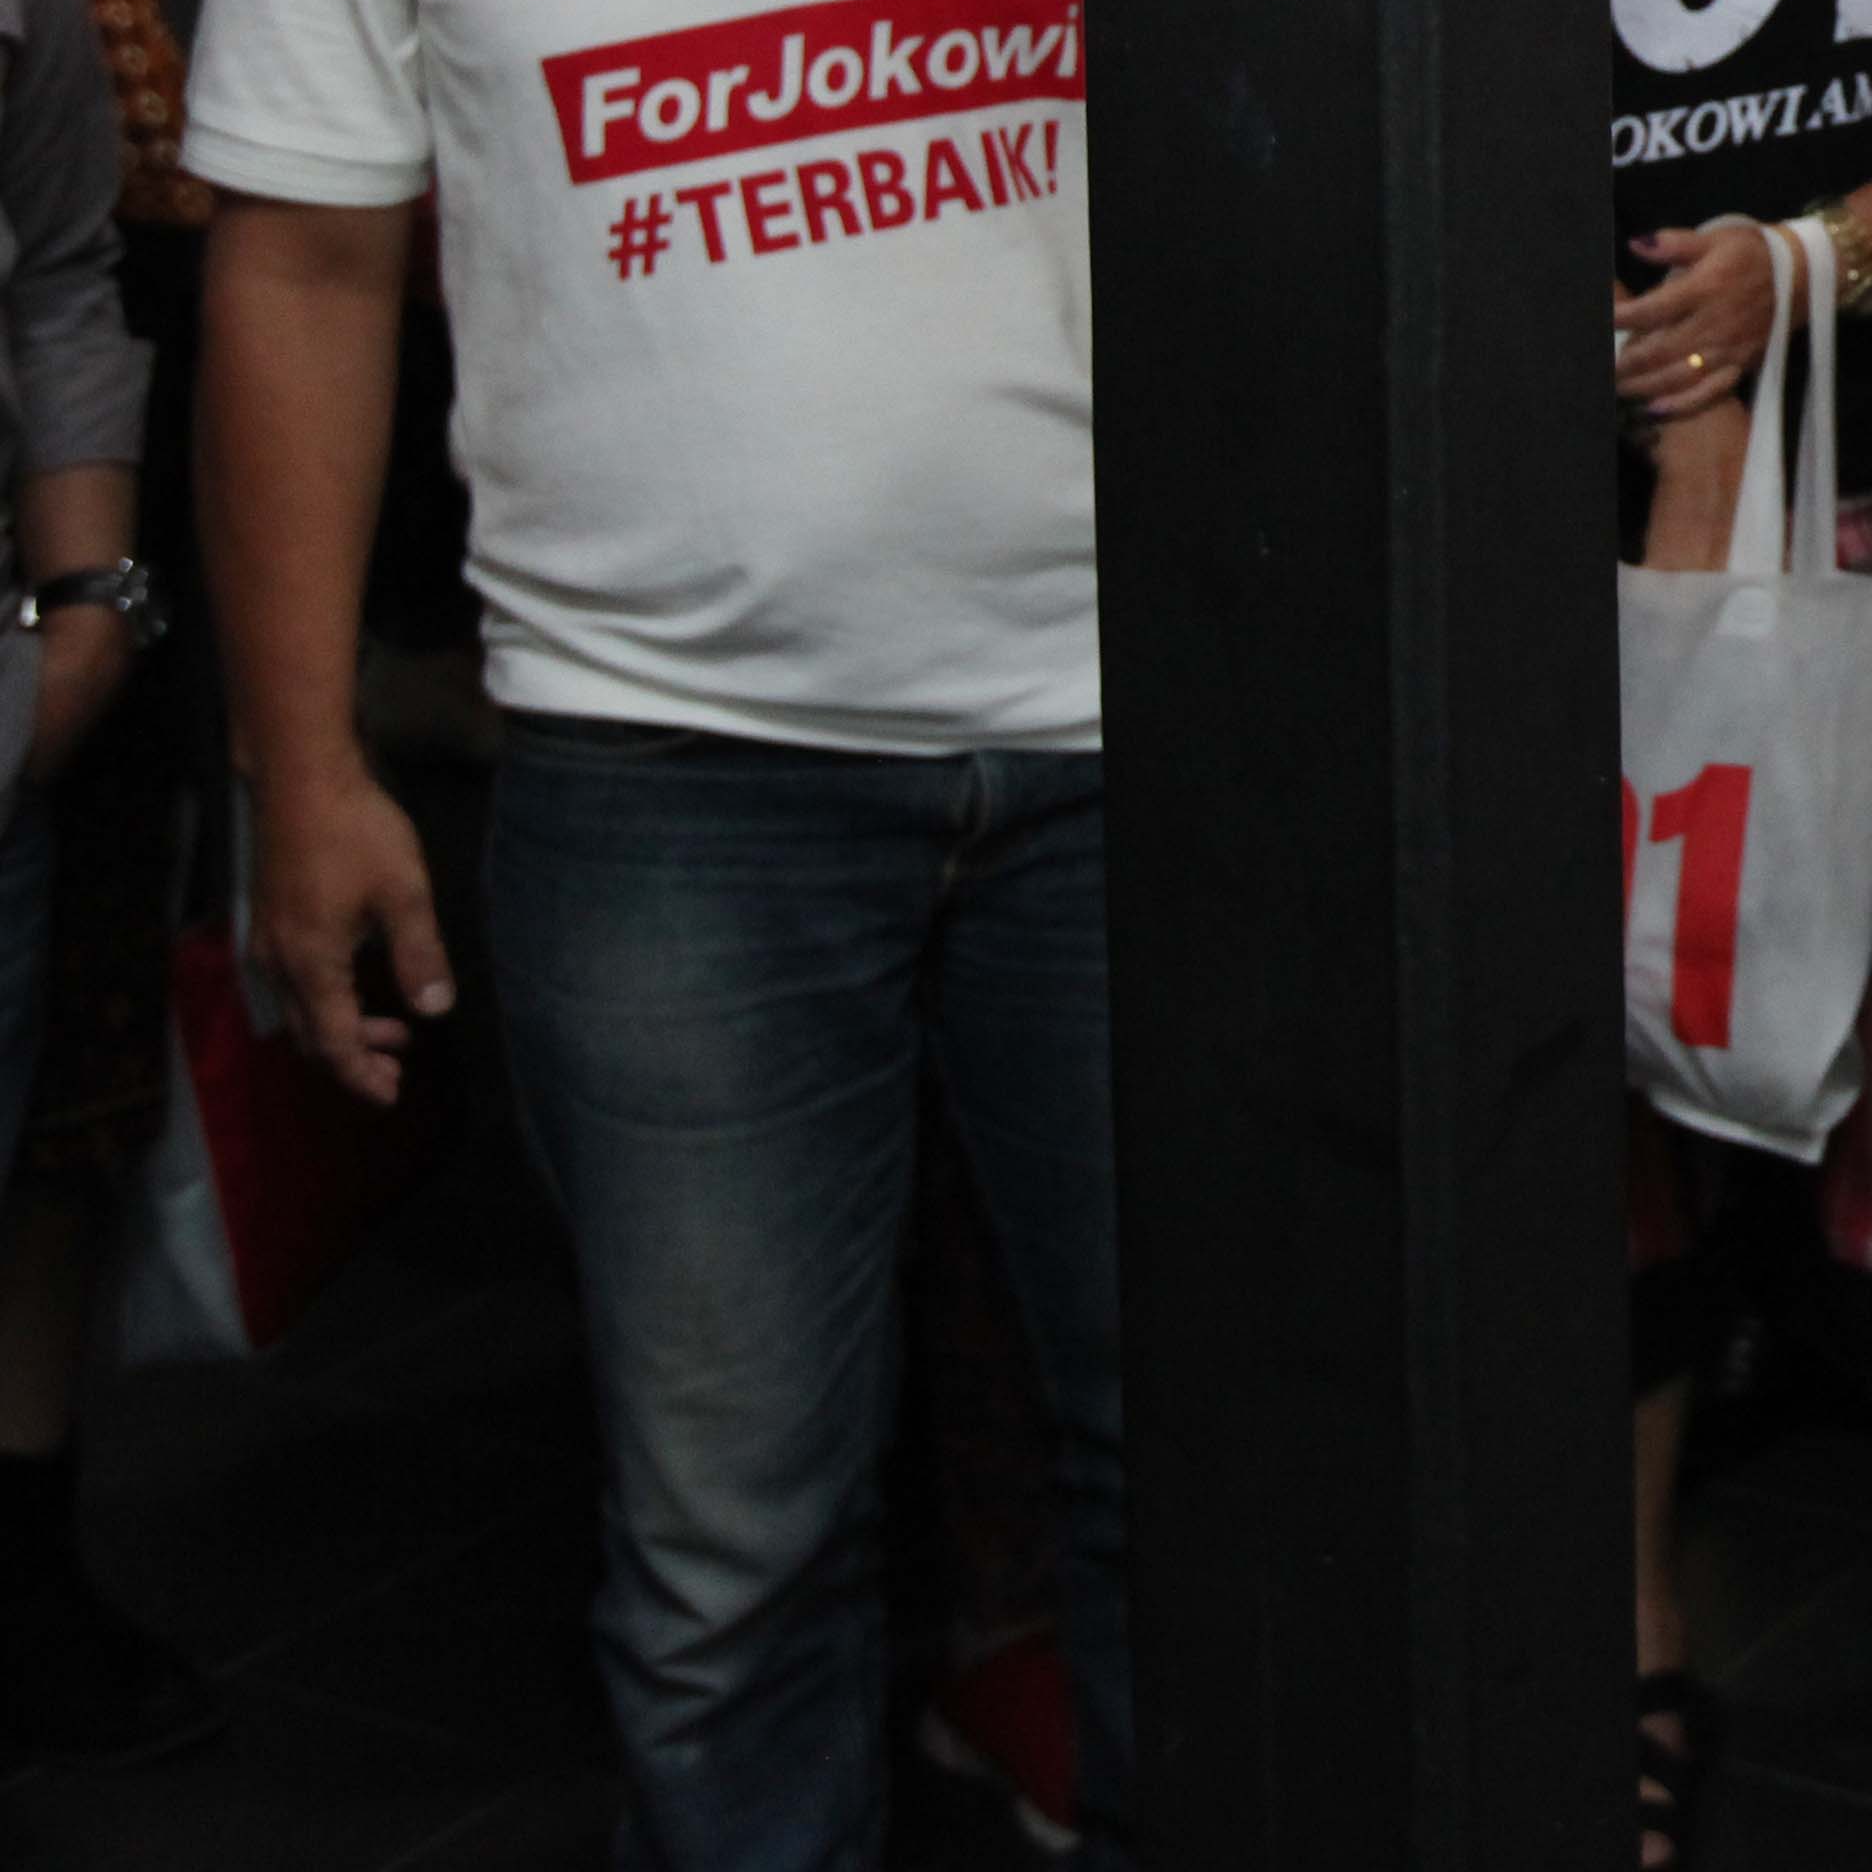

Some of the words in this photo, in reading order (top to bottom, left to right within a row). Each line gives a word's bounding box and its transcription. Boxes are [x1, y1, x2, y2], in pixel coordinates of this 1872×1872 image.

[580, 4, 1079, 160] ForJokowi
[1611, 83, 1807, 168] OKOWI
[606, 121, 1061, 283] #TERBAIK!
[1621, 762, 1753, 1050] 1
